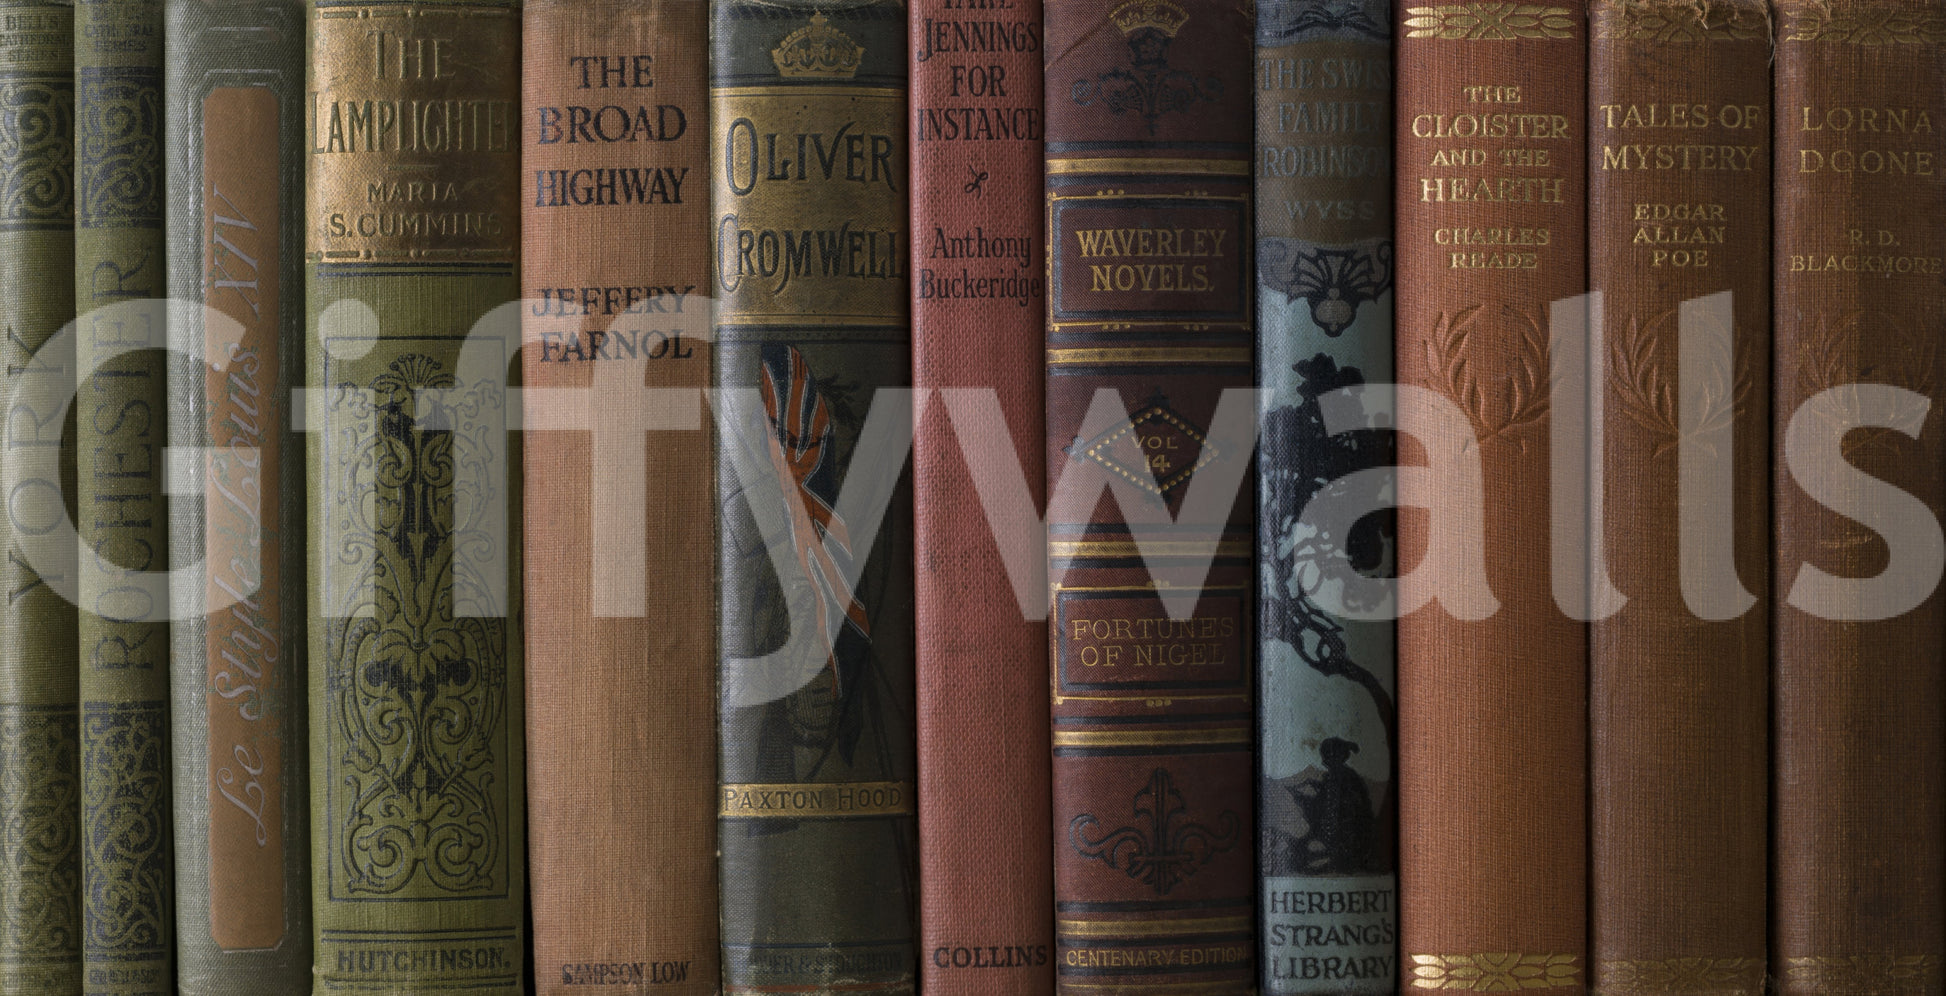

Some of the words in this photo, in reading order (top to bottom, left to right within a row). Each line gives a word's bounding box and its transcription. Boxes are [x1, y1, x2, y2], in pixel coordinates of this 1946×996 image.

[917, 18, 1039, 62] JENNINGS
[367, 30, 457, 81] THE
[570, 55, 654, 90] THE
[950, 65, 1006, 97] FOR
[1259, 57, 1314, 91] THE
[1463, 86, 1521, 104] THE
[537, 104, 688, 146] BROAD
[917, 108, 1040, 141] INSTANCE
[1278, 101, 1385, 134] FAMILY
[1412, 113, 1571, 140] CLOISTER
[1600, 103, 1711, 129] TALES
[1718, 104, 1761, 129] OF
[1799, 106, 1935, 134] LORNA
[725, 117, 897, 196] OLIVER
[1429, 149, 1486, 168] AND
[1499, 149, 1551, 168] THE
[1601, 144, 1759, 171] MYSTERY
[1798, 149, 1935, 176] DOONE
[366, 181, 459, 203] MARIA
[535, 167, 690, 207] HIGHWAY
[1420, 177, 1565, 204] HEARTH
[1284, 200, 1377, 221] WYSS
[1633, 203, 1727, 222] EDGAR
[929, 226, 1032, 268] Anthony
[1075, 229, 1227, 258] WAVERLEY
[1434, 227, 1550, 247] CHARLES
[1632, 226, 1726, 244] ALLAN
[1878, 229, 1902, 247] D.
[212, 182, 259, 319] XIV
[717, 212, 904, 295] CROMWELL
[1448, 252, 1538, 270] READE
[1651, 249, 1709, 267] POE
[1090, 263, 1215, 293] NOVELS.
[1791, 254, 1944, 275] BLACKMORE
[919, 267, 1040, 307] Buckeridge
[532, 285, 697, 318] JEFFERY
[540, 328, 693, 364] FARNOL
[208, 341, 262, 547] Louis
[1131, 435, 1179, 450] VOL
[8, 324, 65, 604] YORK
[92, 247, 154, 671] ROCHESTER
[1144, 454, 1172, 474] 14
[214, 556, 279, 721] Style
[1071, 616, 1234, 642] FORTUNES
[1080, 645, 1123, 668] OF
[1133, 642, 1226, 668] NIGEL
[216, 744, 267, 848] Le
[723, 787, 825, 811] PAXTON
[834, 786, 901, 811] HOOD
[1269, 888, 1394, 915] HERBERT
[1269, 916, 1395, 948] STRANG'S
[337, 946, 513, 974] HUTCHINSON.
[932, 944, 1048, 969] COLLINS
[1065, 948, 1175, 968] CENTENARY
[1179, 945, 1248, 967] EDITION
[1269, 954, 1394, 981] LIBRARY
[562, 962, 647, 986] SAMPSON
[651, 960, 692, 985] LOW
